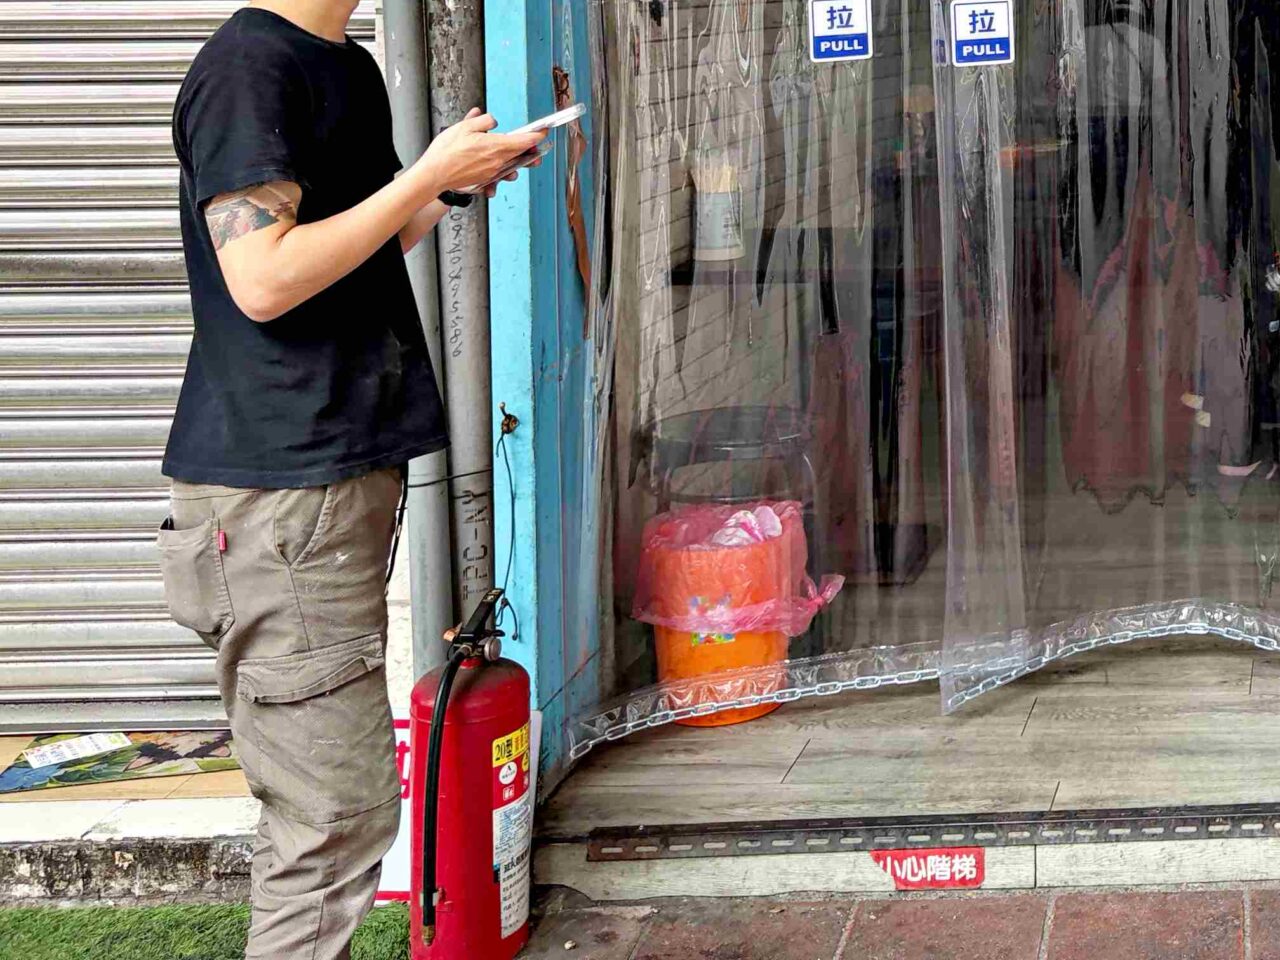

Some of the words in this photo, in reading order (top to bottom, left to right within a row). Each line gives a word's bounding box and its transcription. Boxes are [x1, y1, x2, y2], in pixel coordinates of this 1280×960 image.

[826, 5, 854, 29] 拉
[968, 9, 996, 34] 拉
[820, 39, 863, 52] PULL
[962, 43, 1005, 56] PULL
[880, 854, 977, 882] 小心階梯
